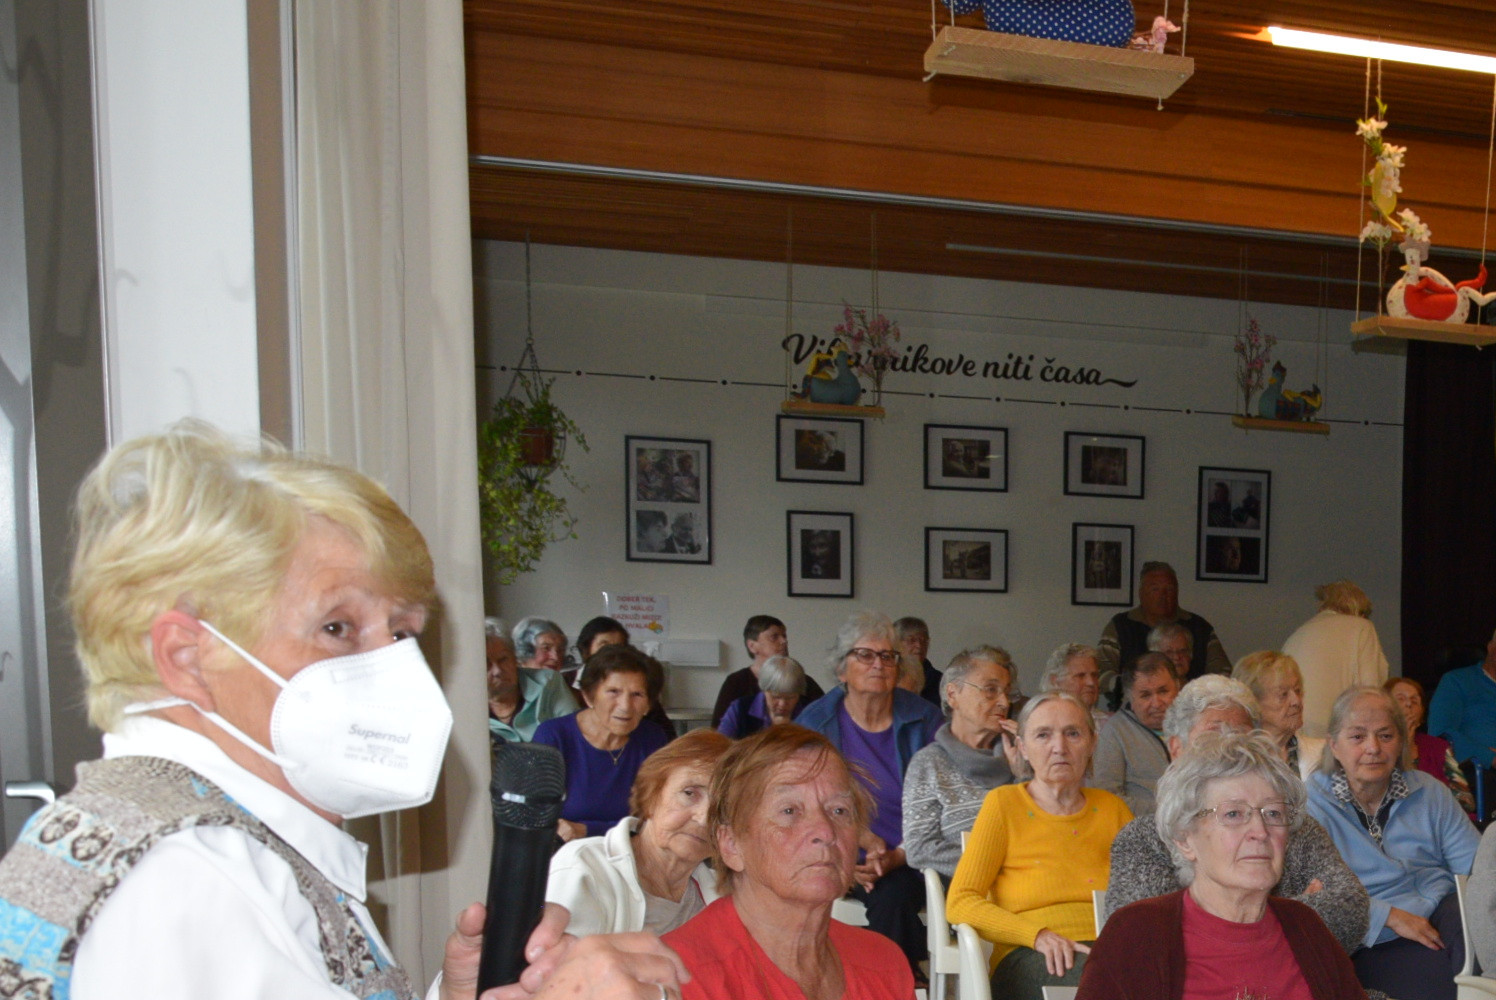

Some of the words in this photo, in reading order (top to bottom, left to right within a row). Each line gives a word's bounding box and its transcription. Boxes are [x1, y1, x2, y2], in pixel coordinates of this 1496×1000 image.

[982, 352, 1033, 381] niti
[1039, 356, 1137, 388] časa
[348, 723, 411, 744] Supernal
